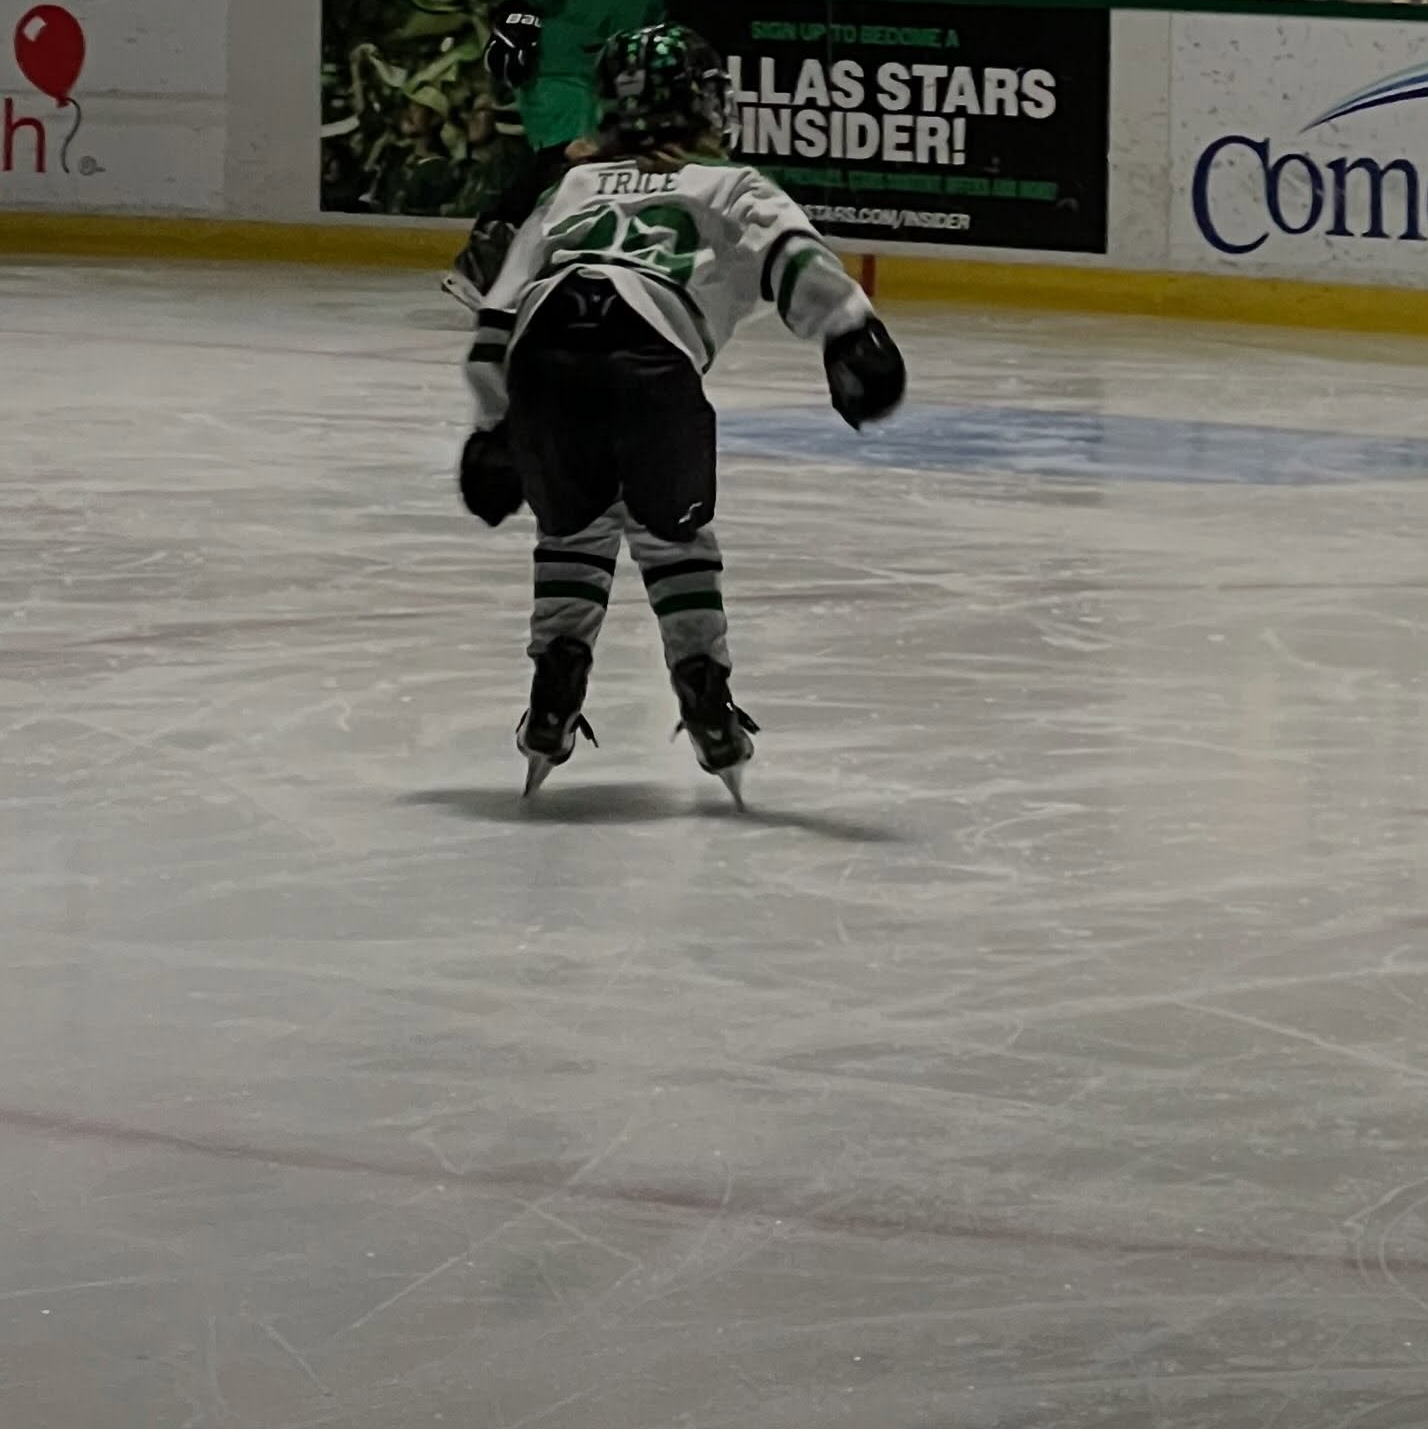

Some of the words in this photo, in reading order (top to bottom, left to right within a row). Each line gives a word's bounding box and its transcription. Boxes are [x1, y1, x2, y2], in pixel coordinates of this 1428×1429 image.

[751, 20, 796, 41] SIGN
[799, 22, 827, 42] UP
[829, 23, 857, 44] TO
[945, 28, 961, 48] A
[727, 54, 865, 110] LLAS
[876, 61, 1057, 119] STARS
[741, 105, 967, 166] INSIDER!
[597, 172, 680, 195] TRICE
[802, 203, 972, 231] STARS.COM/INSIDER
